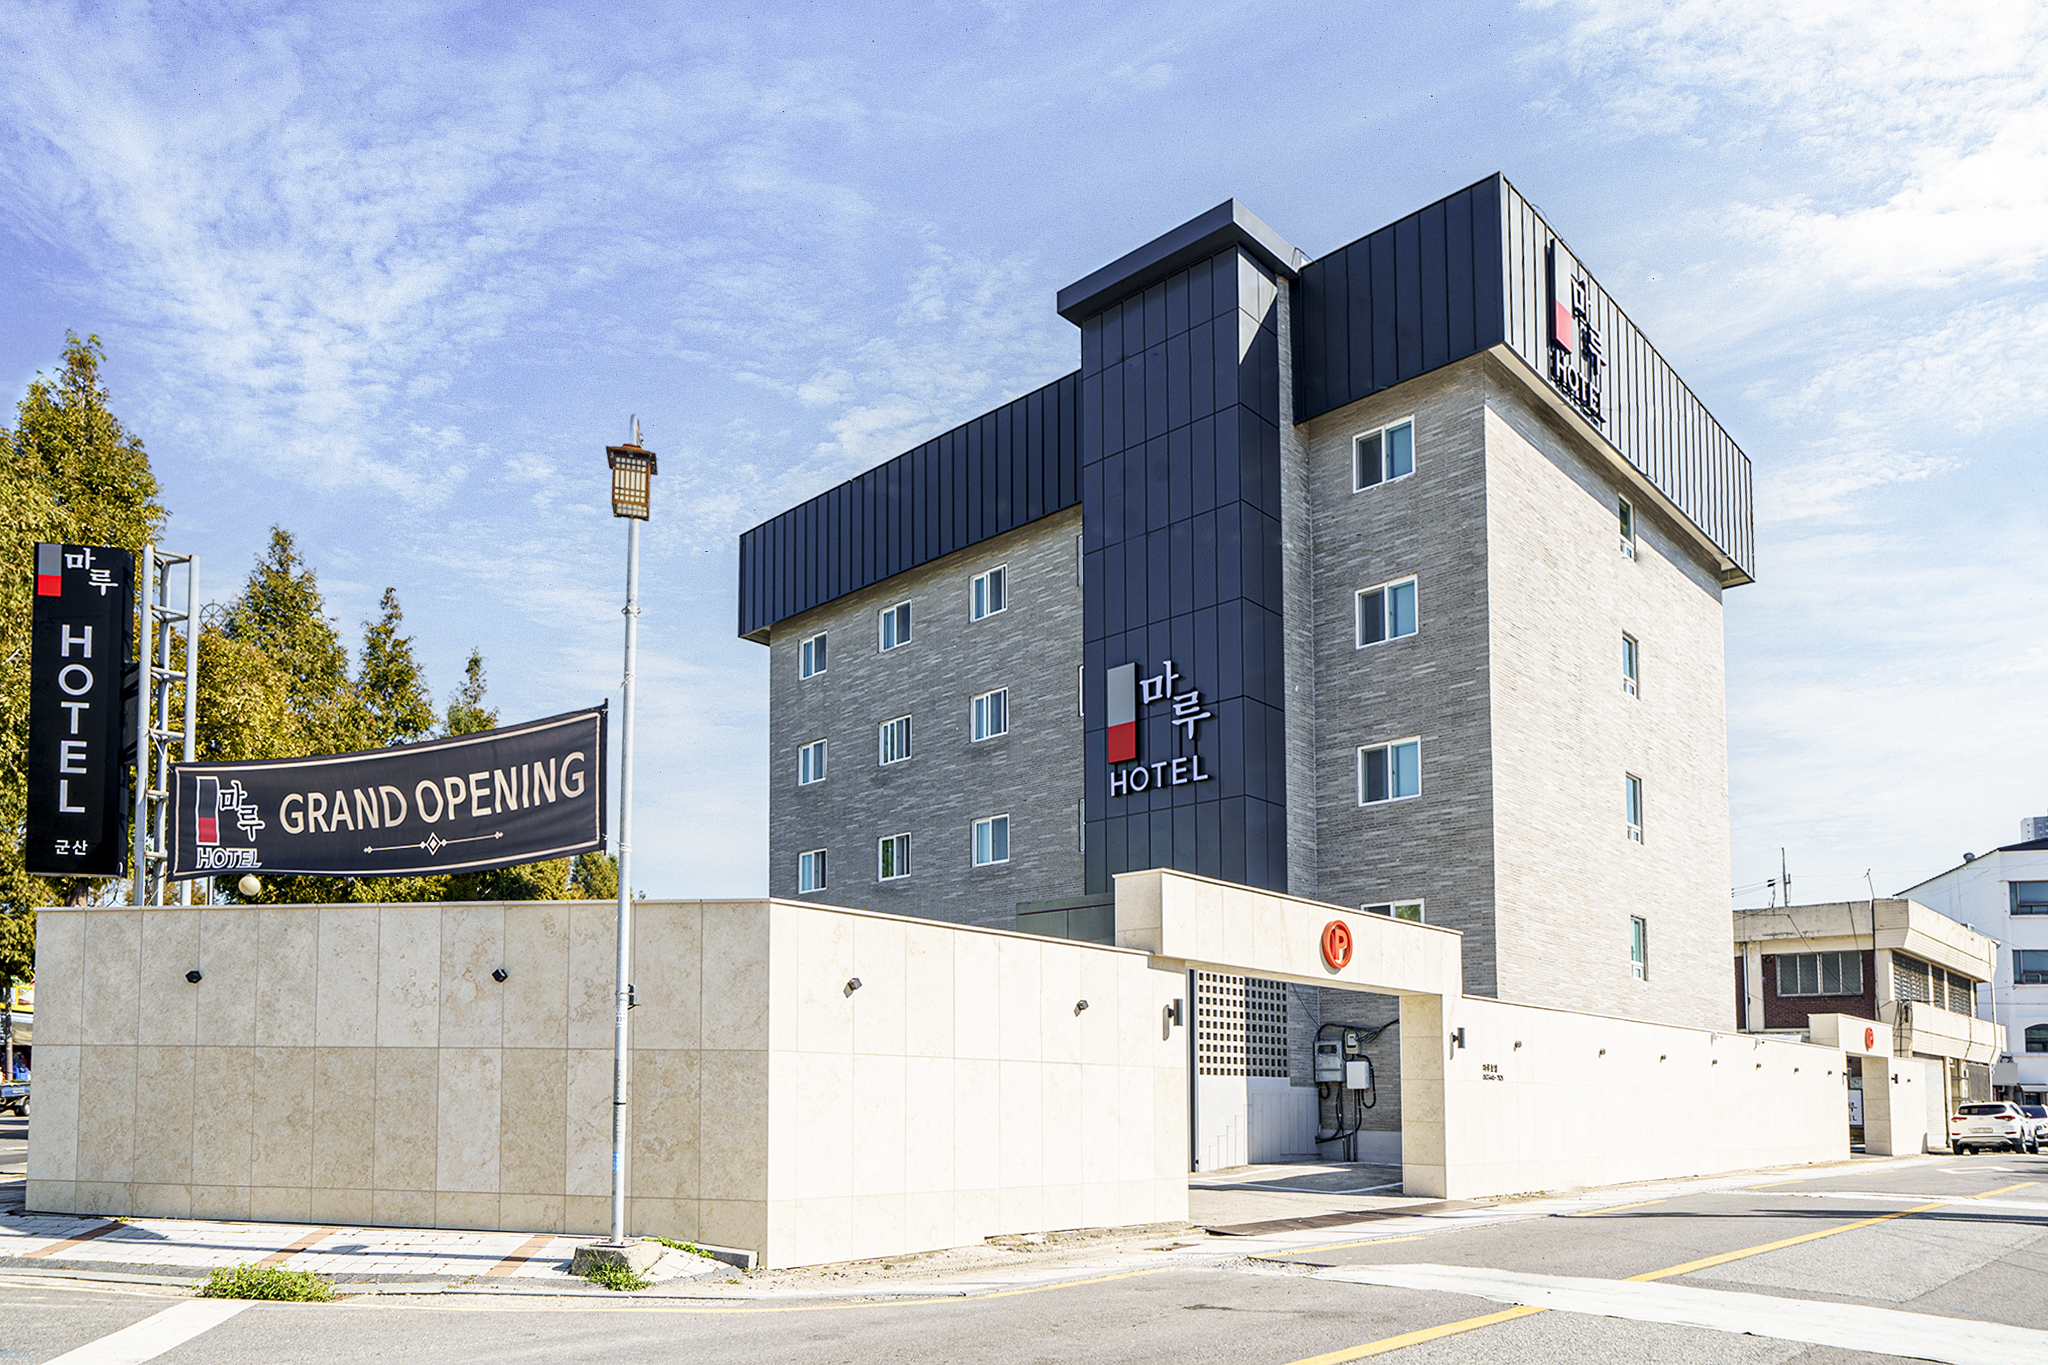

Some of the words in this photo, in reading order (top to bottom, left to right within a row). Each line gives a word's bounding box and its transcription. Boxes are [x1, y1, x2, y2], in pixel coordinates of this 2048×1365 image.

[1555, 349, 1607, 422] HOTEL
[64, 547, 119, 597] 마루
[57, 624, 95, 813] HOTEL
[1139, 660, 1212, 740] 마루
[279, 785, 408, 834] GRAND
[414, 751, 585, 824] OPENING
[1110, 754, 1209, 797] HOTEL
[219, 779, 266, 842] 마루
[54, 839, 88, 856] 군산
[195, 847, 262, 869] HOTEL
